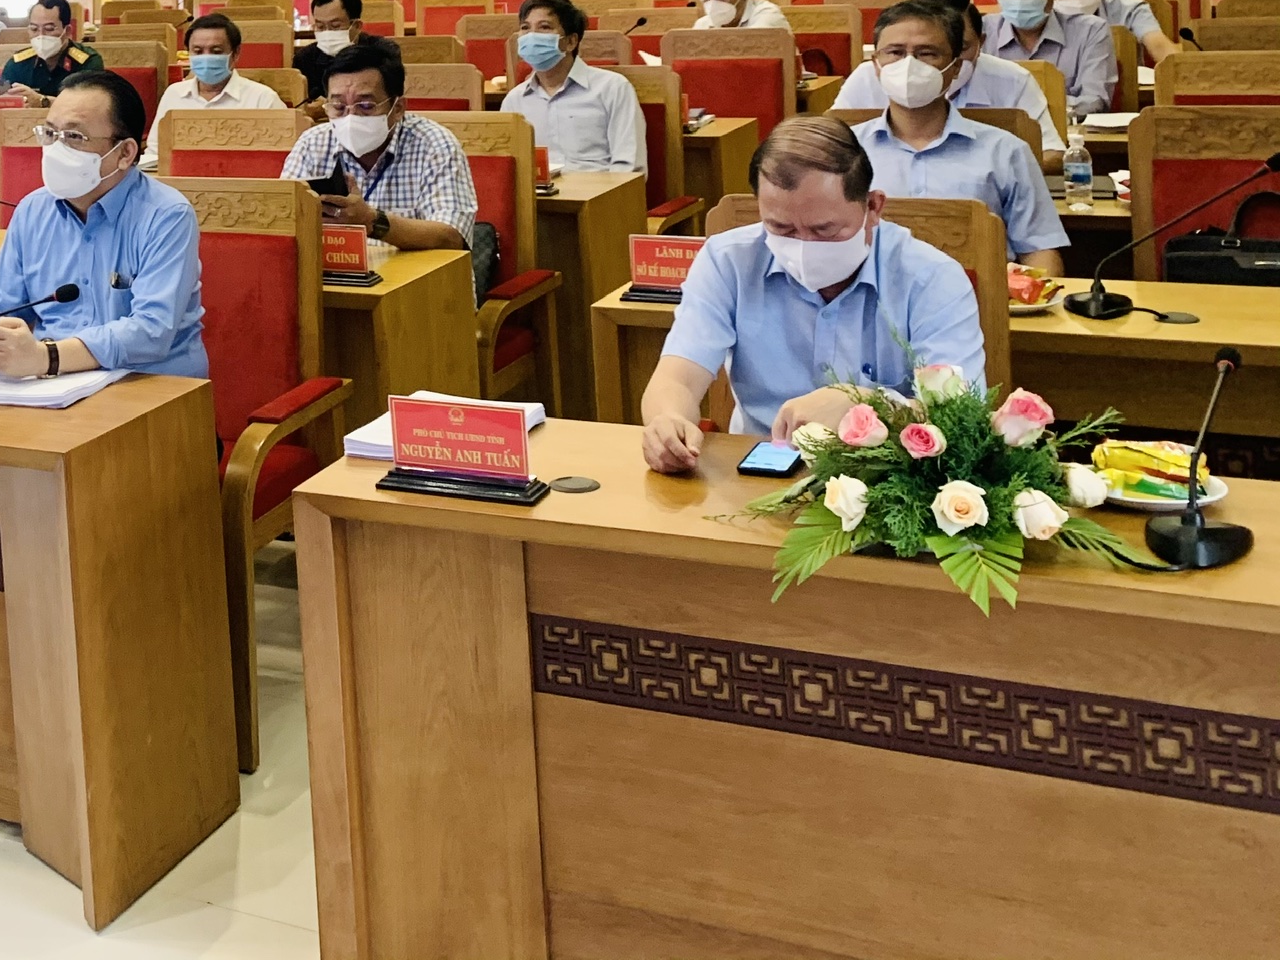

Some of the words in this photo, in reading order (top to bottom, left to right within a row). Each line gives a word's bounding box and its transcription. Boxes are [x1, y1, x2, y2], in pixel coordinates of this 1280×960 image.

[326, 250, 360, 264] CHÍNH
[655, 246, 683, 258] LÃNH
[636, 261, 647, 275] SỞ
[648, 262, 659, 277] KẾ
[660, 266, 687, 279] HOẠCH
[413, 427, 428, 437] PHÓ
[465, 433, 485, 443] UBND
[401, 441, 452, 461] NGUYỄN
[455, 449, 482, 465] ANH
[485, 448, 520, 468] TUẤN
